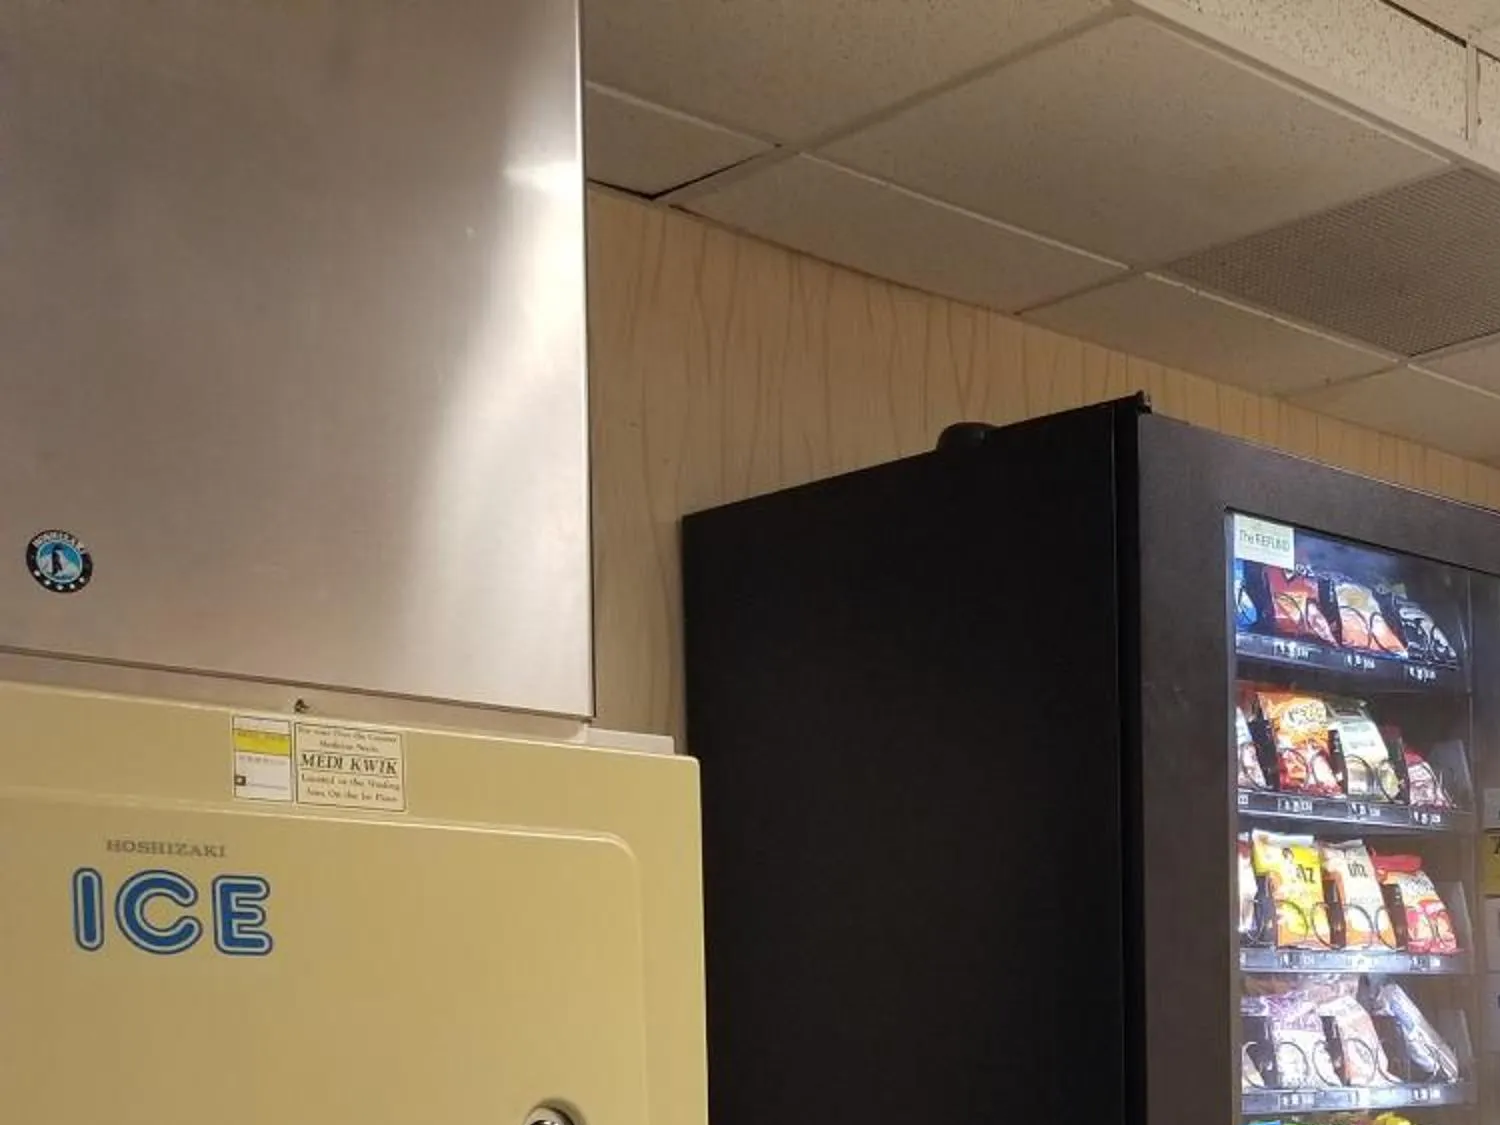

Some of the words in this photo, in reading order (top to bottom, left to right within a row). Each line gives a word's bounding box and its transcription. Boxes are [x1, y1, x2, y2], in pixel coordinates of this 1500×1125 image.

[301, 753, 343, 770] MEDI
[350, 757, 398, 775] KWIK
[106, 839, 227, 858] HOSHIZAKI
[73, 867, 274, 956] ICE
